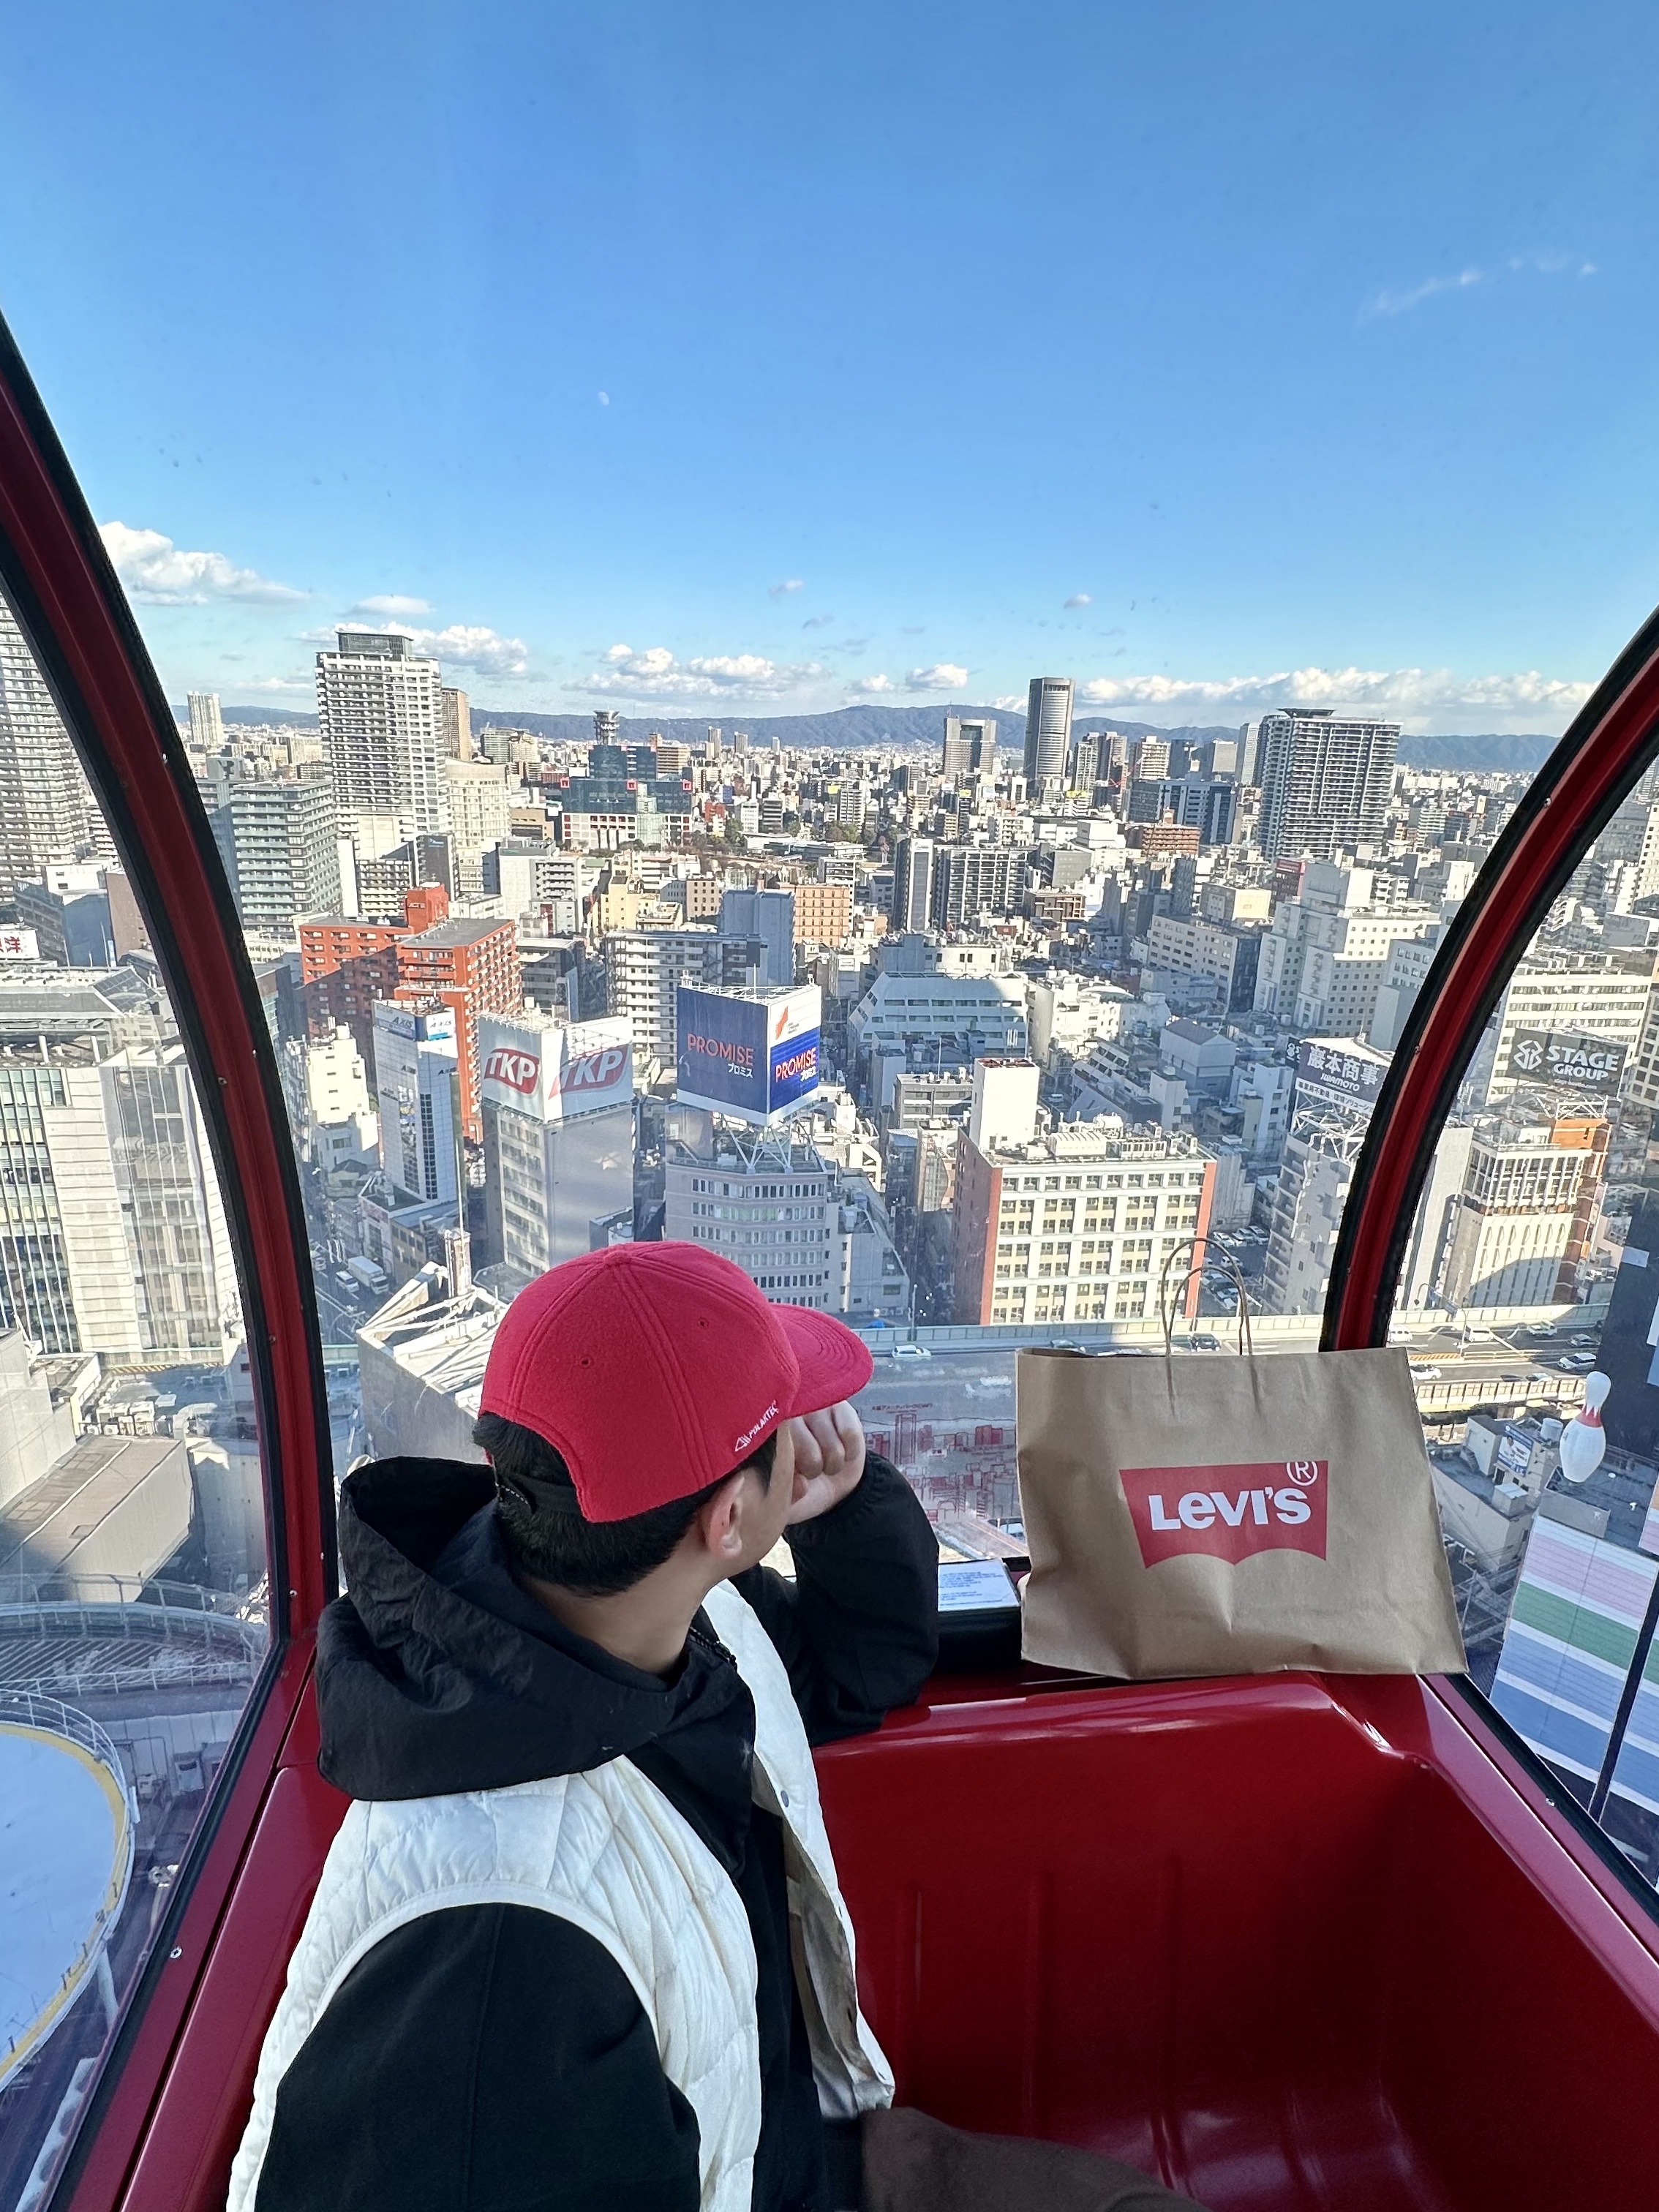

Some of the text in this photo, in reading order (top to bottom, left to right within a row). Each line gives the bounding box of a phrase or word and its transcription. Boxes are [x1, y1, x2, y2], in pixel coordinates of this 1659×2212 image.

[0, 936, 21, 953] 洋
[392, 1017, 414, 1028] AXIS
[687, 1033, 754, 1066] PROMISE
[1546, 1045, 1620, 1072] STAGE
[489, 1052, 536, 1086] TKP
[560, 1050, 623, 1088] TKP
[728, 1063, 753, 1078] プロミス
[775, 1047, 816, 1083] PROMISE
[1554, 1064, 1608, 1081] GROUP
